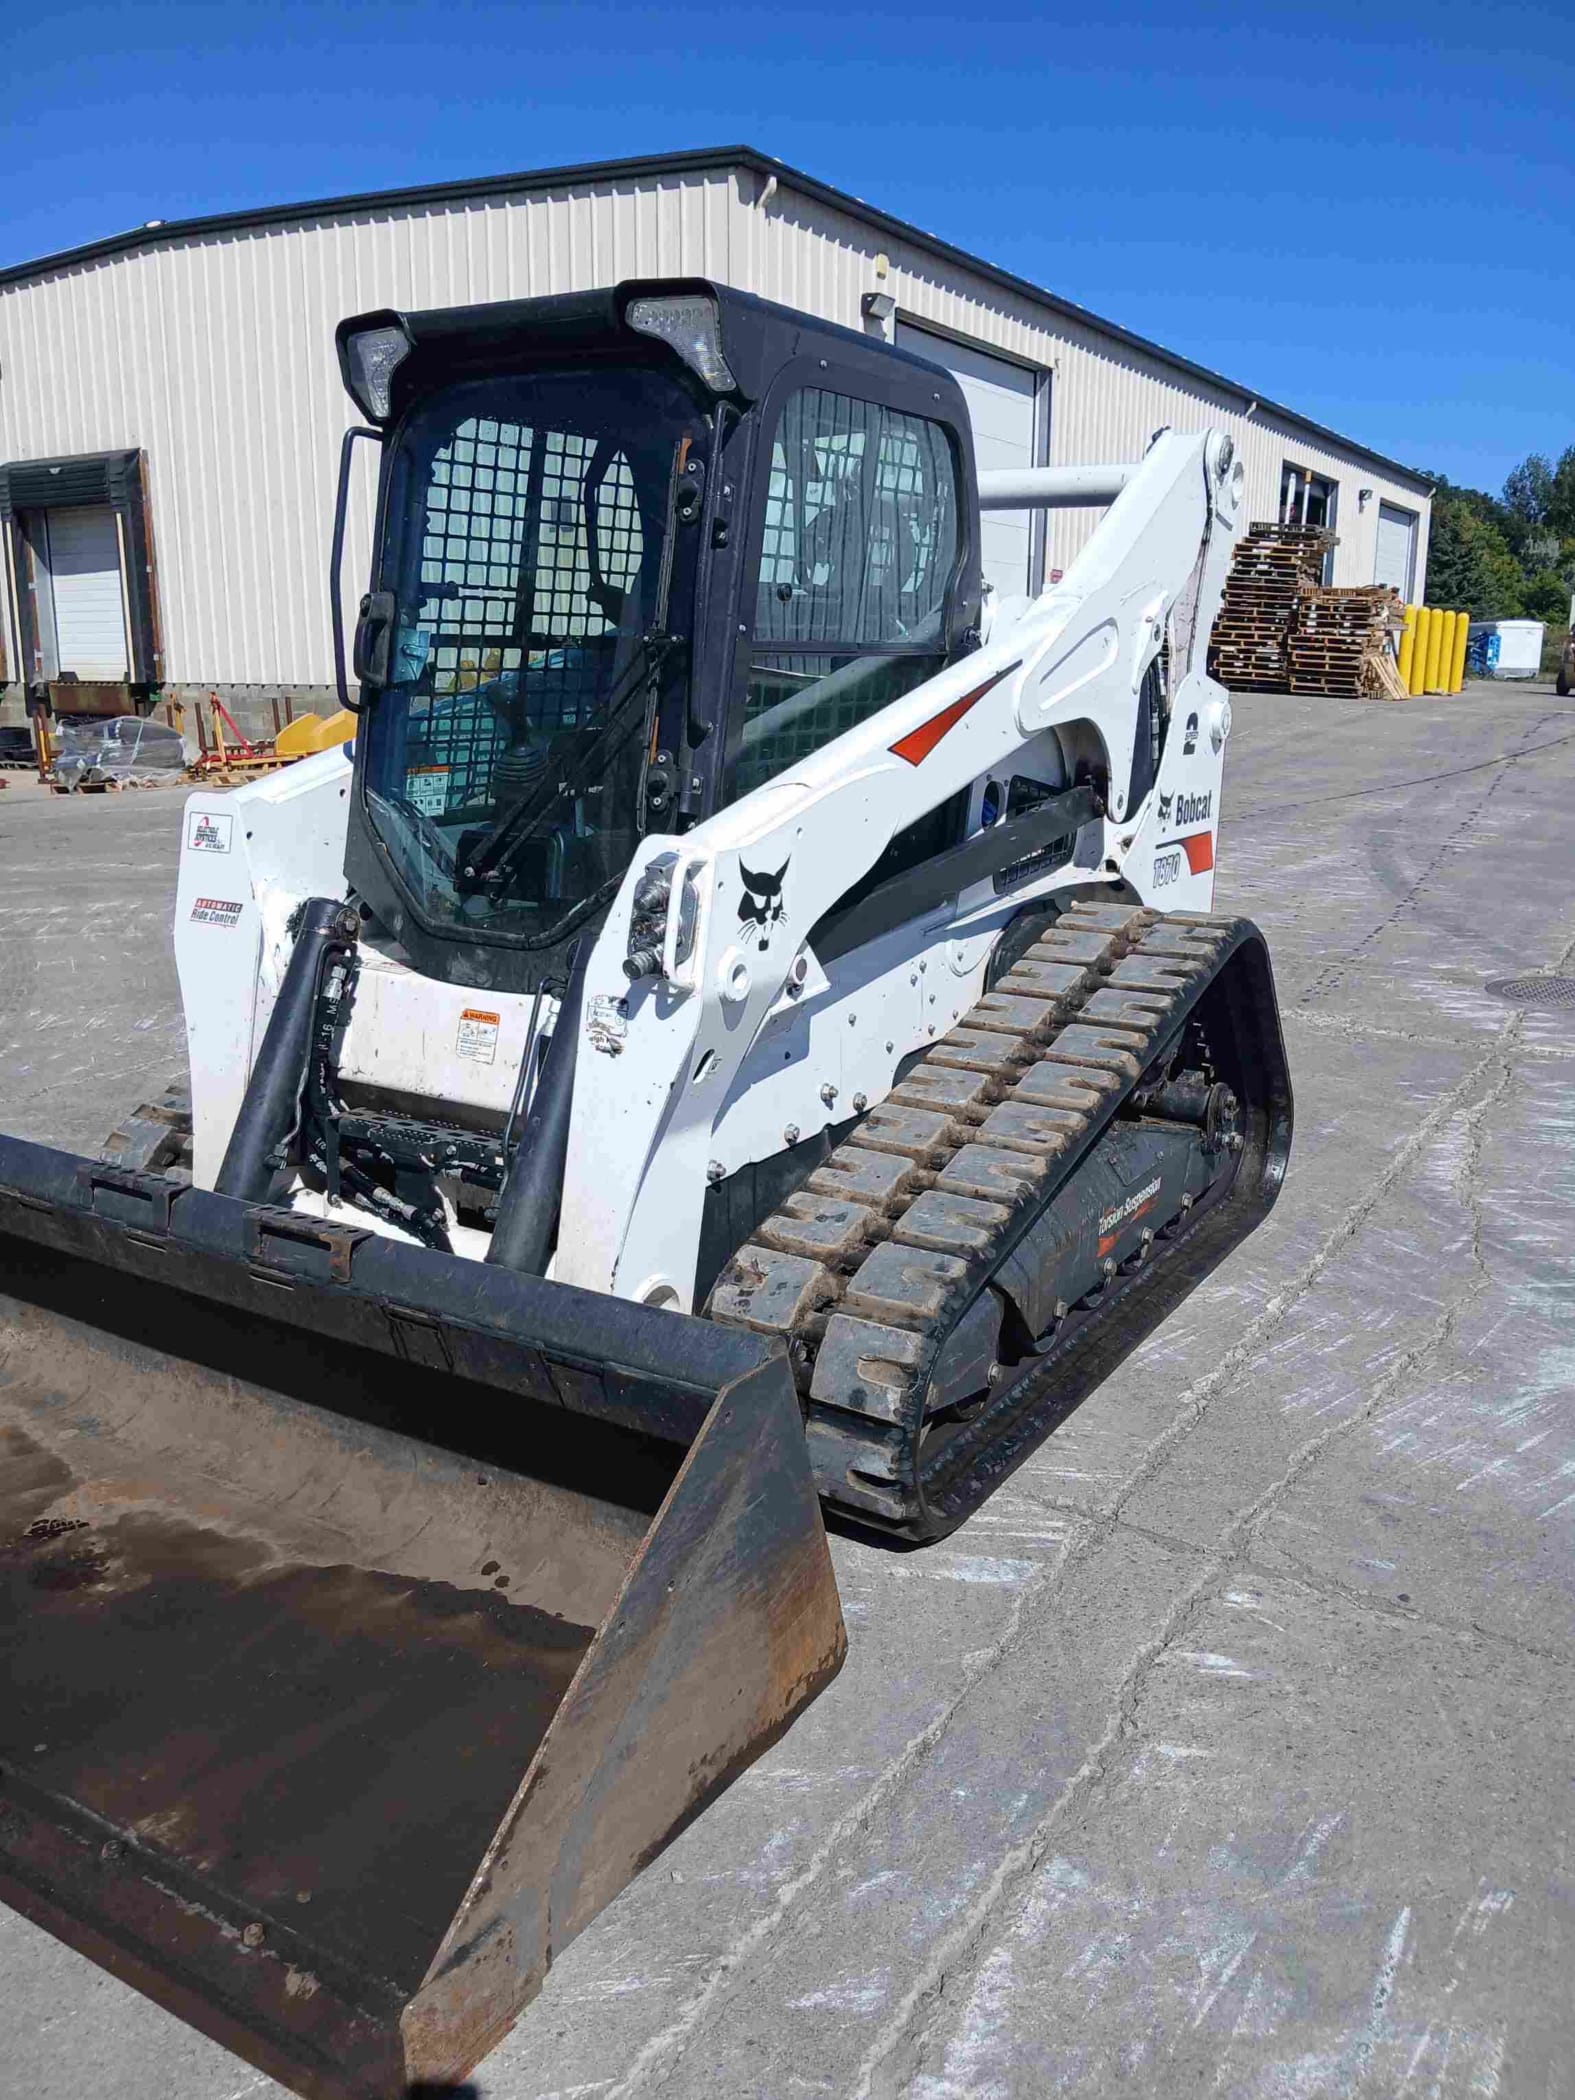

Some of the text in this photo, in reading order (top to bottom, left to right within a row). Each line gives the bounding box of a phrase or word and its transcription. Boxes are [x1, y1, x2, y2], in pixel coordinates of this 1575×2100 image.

[1176, 789, 1212, 827] Bobcat
[1153, 853, 1180, 888] T870
[191, 908, 240, 926] Ride Control
[196, 899, 242, 913] AUTOMATIC
[469, 1011, 497, 1023] WARNING
[1124, 1176, 1162, 1217] Suspension
